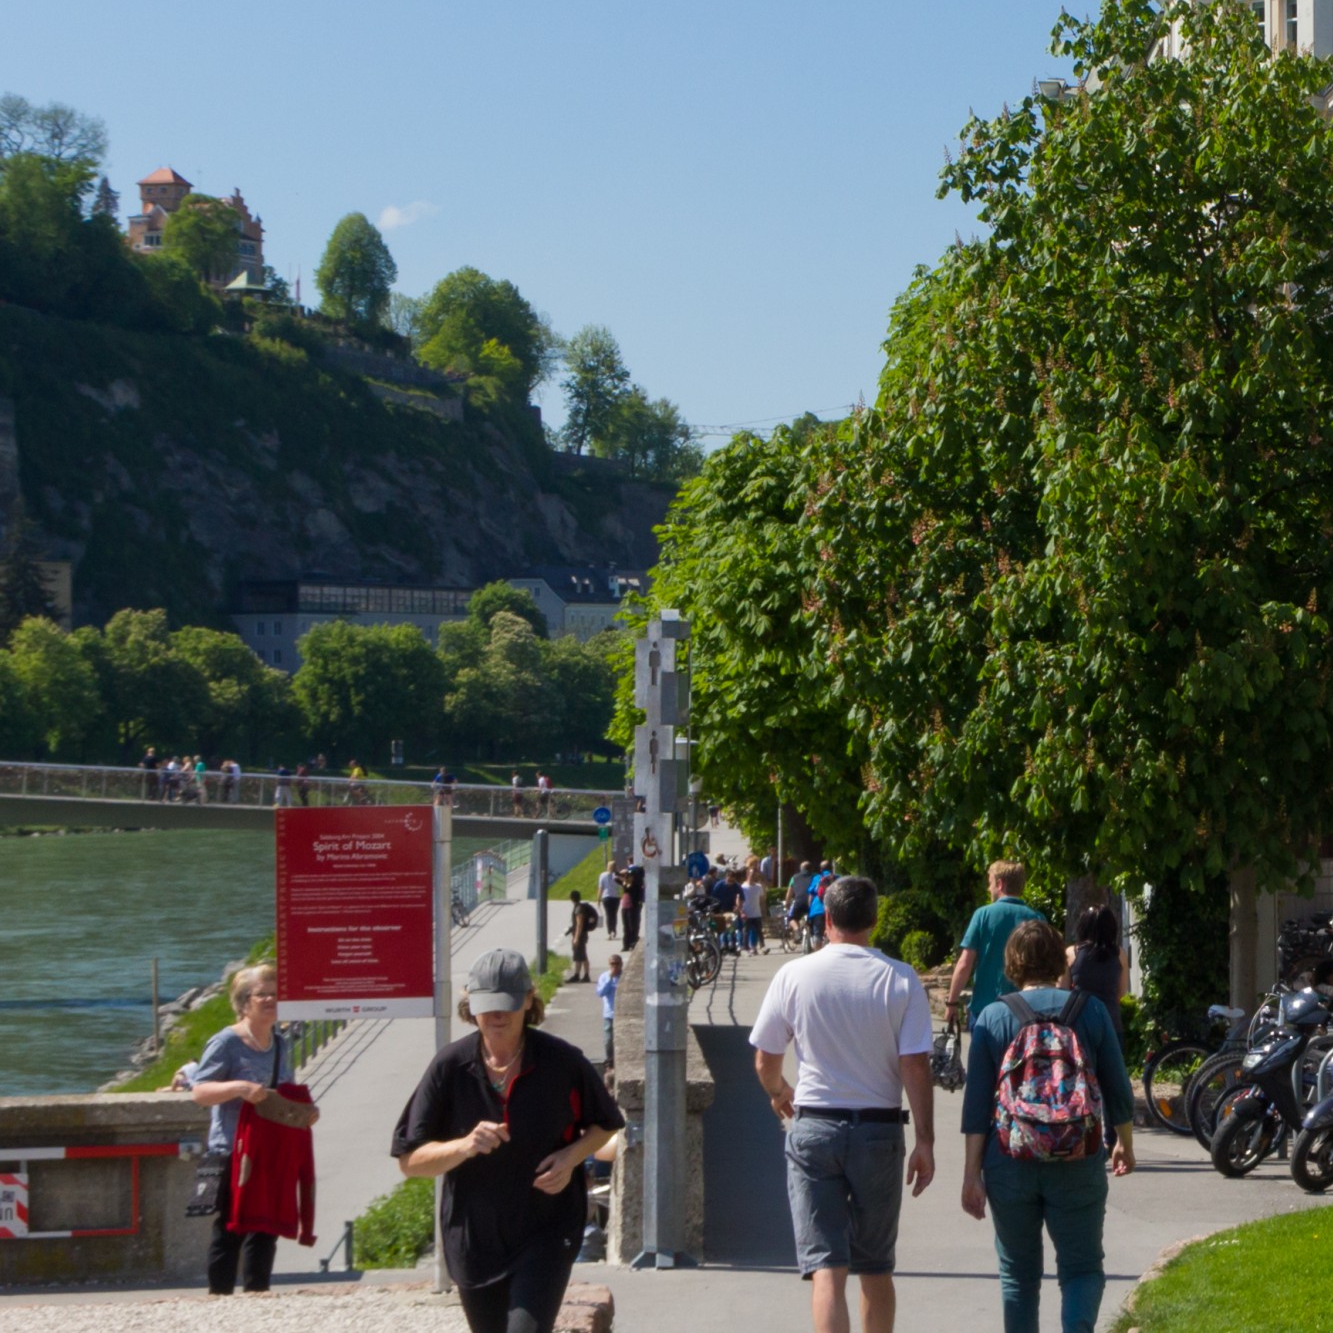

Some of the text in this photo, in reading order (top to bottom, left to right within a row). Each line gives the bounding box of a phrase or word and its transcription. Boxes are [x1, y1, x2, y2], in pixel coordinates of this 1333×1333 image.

[313, 840, 392, 852] Spirit of Mozart
